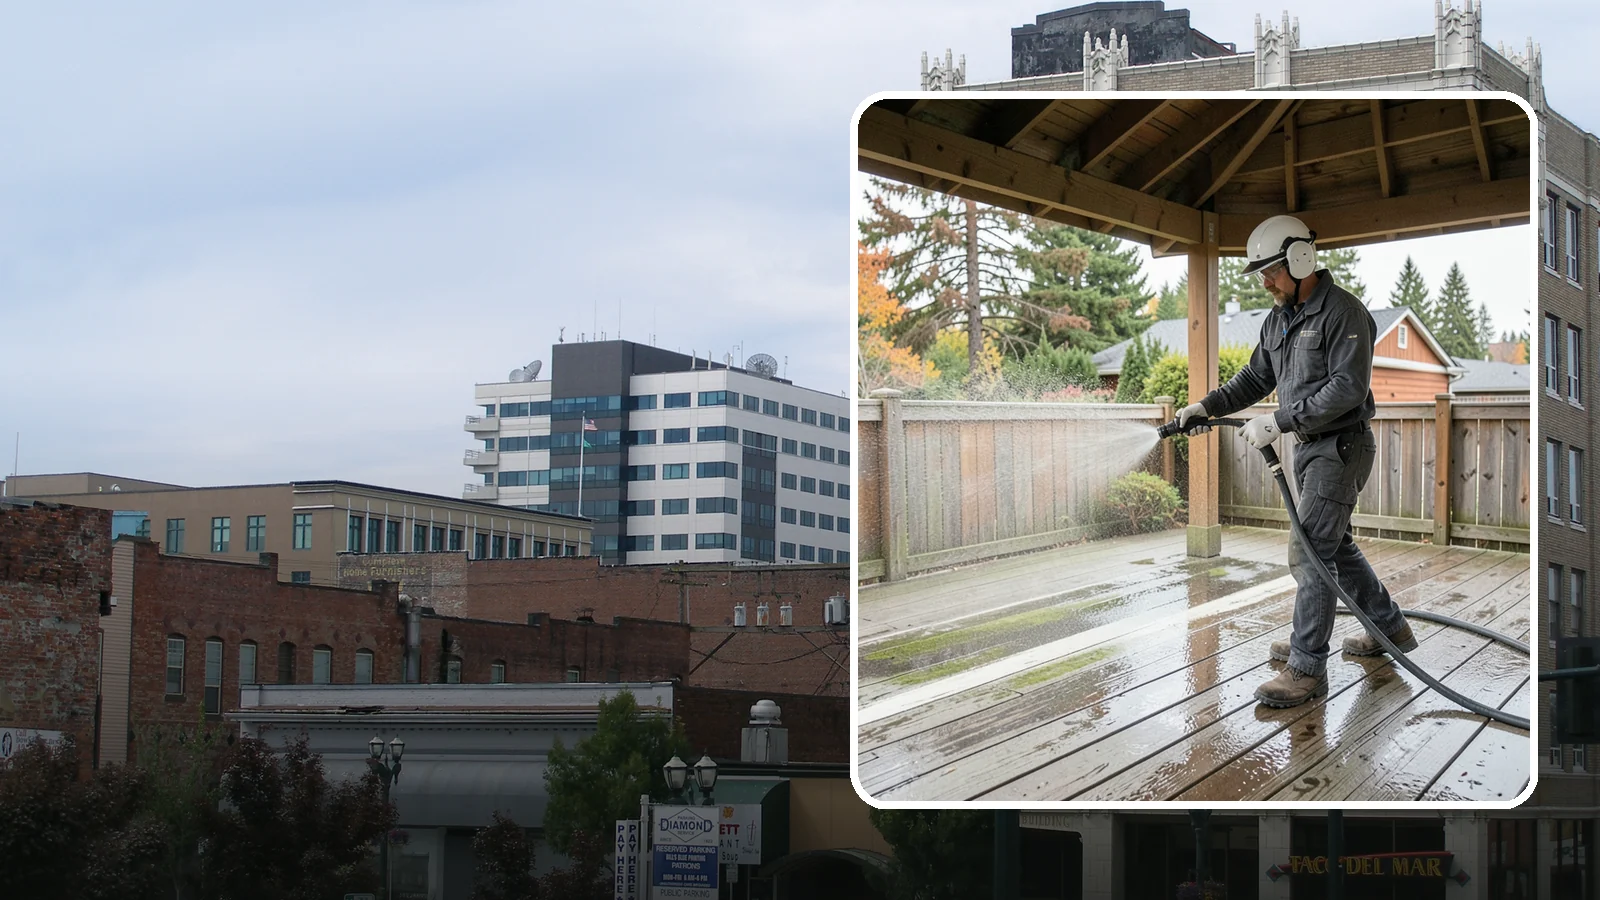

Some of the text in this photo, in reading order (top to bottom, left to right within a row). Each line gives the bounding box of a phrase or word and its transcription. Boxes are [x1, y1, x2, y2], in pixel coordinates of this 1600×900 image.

[343, 566, 427, 577] Home Furnishers
[660, 818, 713, 833] DIAMOND
[1021, 815, 1070, 828] BUILDING
[655, 845, 688, 853] RESERVED
[616, 824, 625, 893] PAY HERE
[627, 824, 637, 893] PAY HERE
[721, 851, 739, 862] Soup
[671, 862, 701, 870] PATRONS
[1346, 856, 1385, 875] DEL
[1392, 857, 1443, 877] MAR
[660, 888, 710, 898] PUBLIC PARKING
